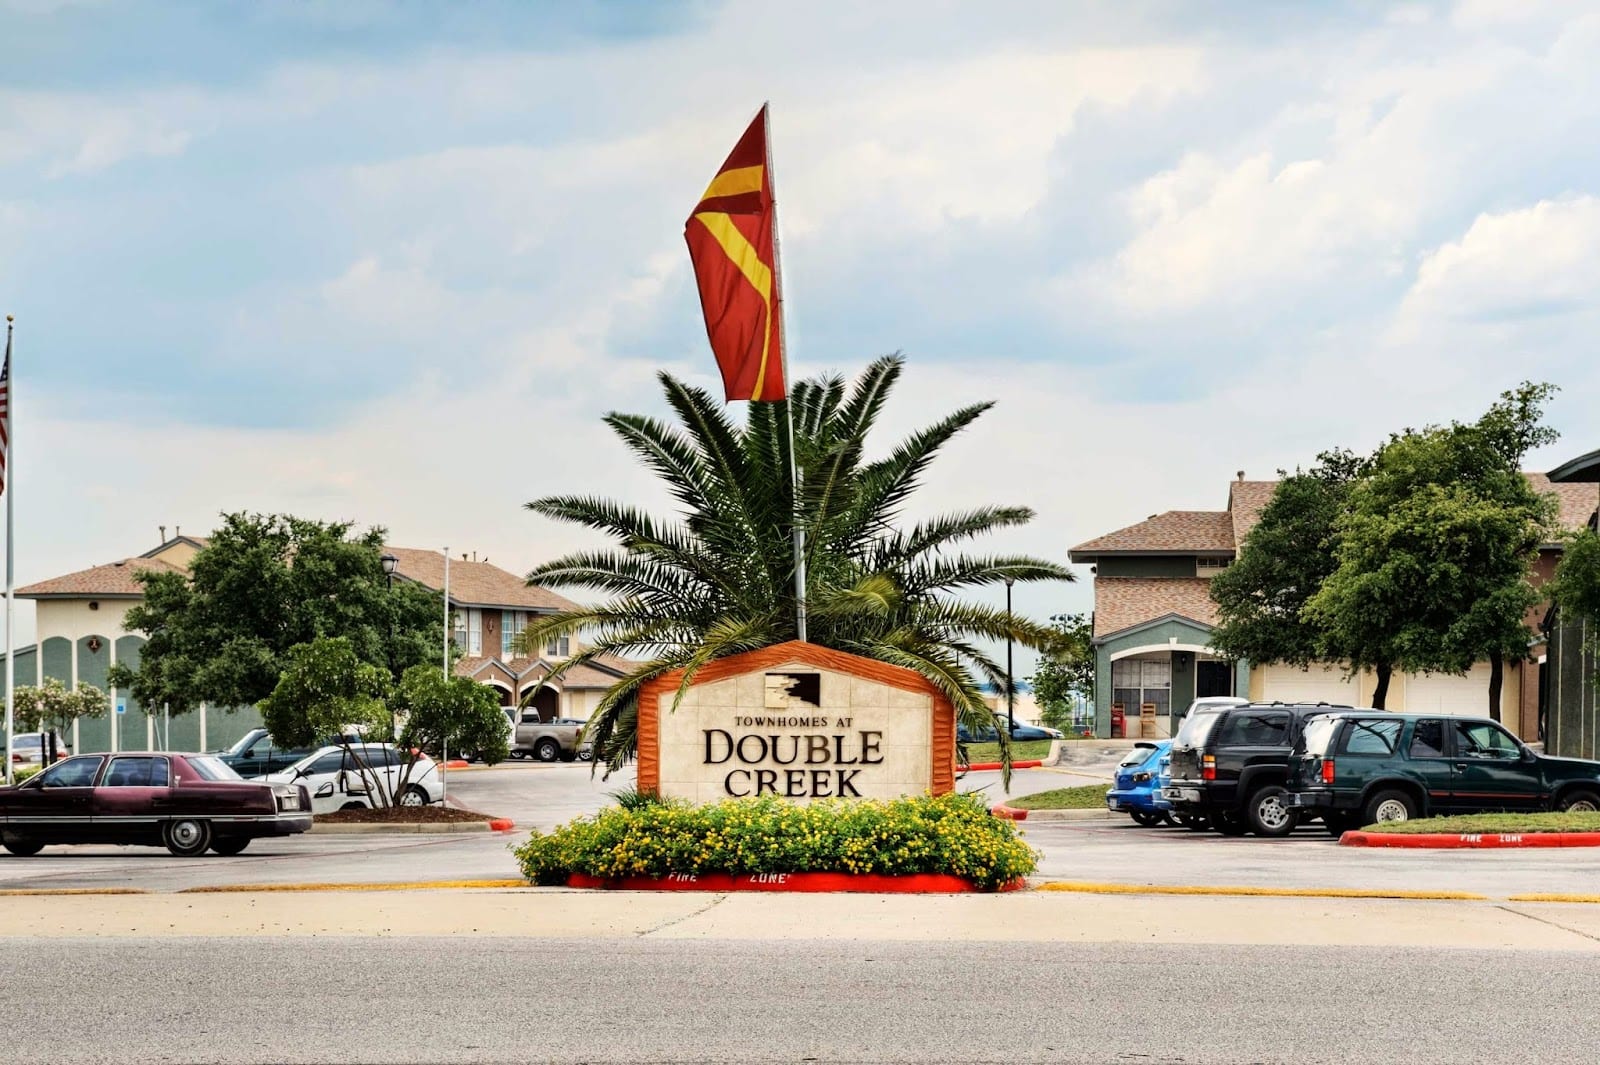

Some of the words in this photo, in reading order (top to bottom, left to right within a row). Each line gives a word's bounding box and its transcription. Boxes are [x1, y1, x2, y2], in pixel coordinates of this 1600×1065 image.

[735, 716, 828, 727] TOWNHOMES
[836, 717, 854, 727] AT
[702, 729, 884, 765] DOUBLE
[724, 769, 863, 798] CREEK
